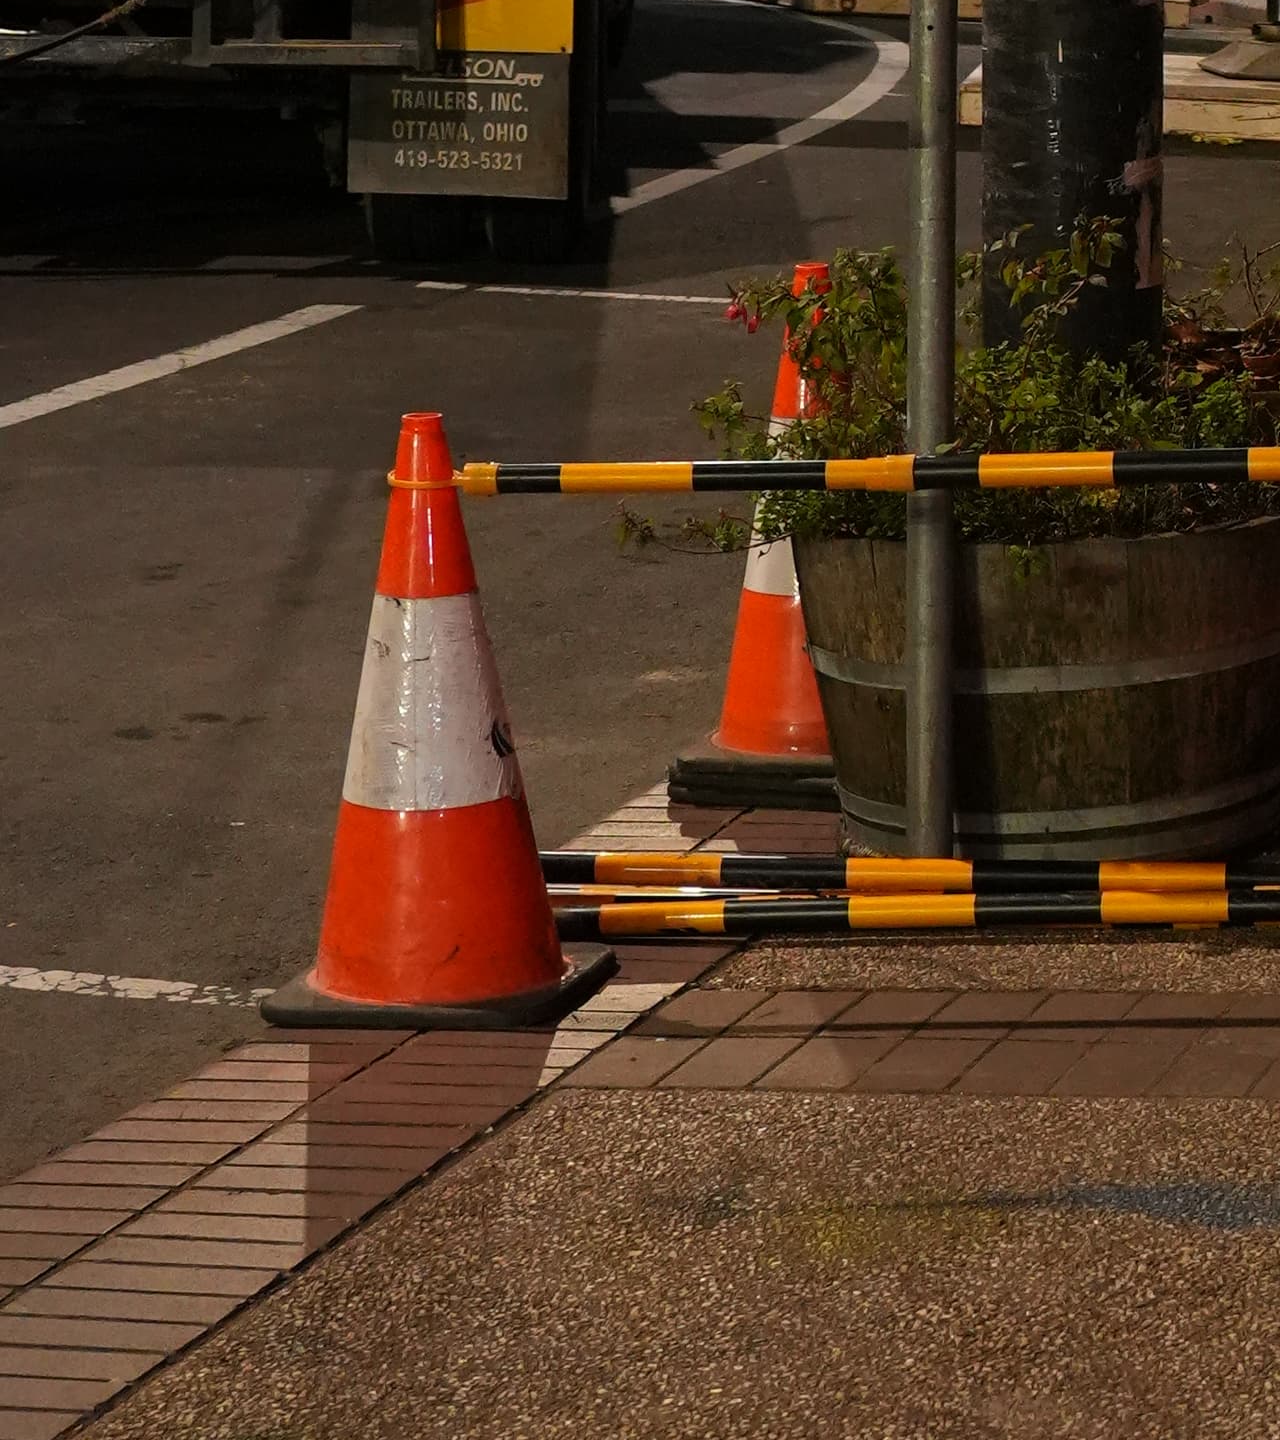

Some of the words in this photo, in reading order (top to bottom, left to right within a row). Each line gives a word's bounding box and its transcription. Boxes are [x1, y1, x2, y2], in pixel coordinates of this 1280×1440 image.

[391, 89, 484, 113] TRAILERS,
[490, 92, 529, 113] INC.
[392, 120, 475, 144] OTTAWA,
[483, 122, 529, 143] OHIO
[394, 148, 523, 171] 419-523-5321
